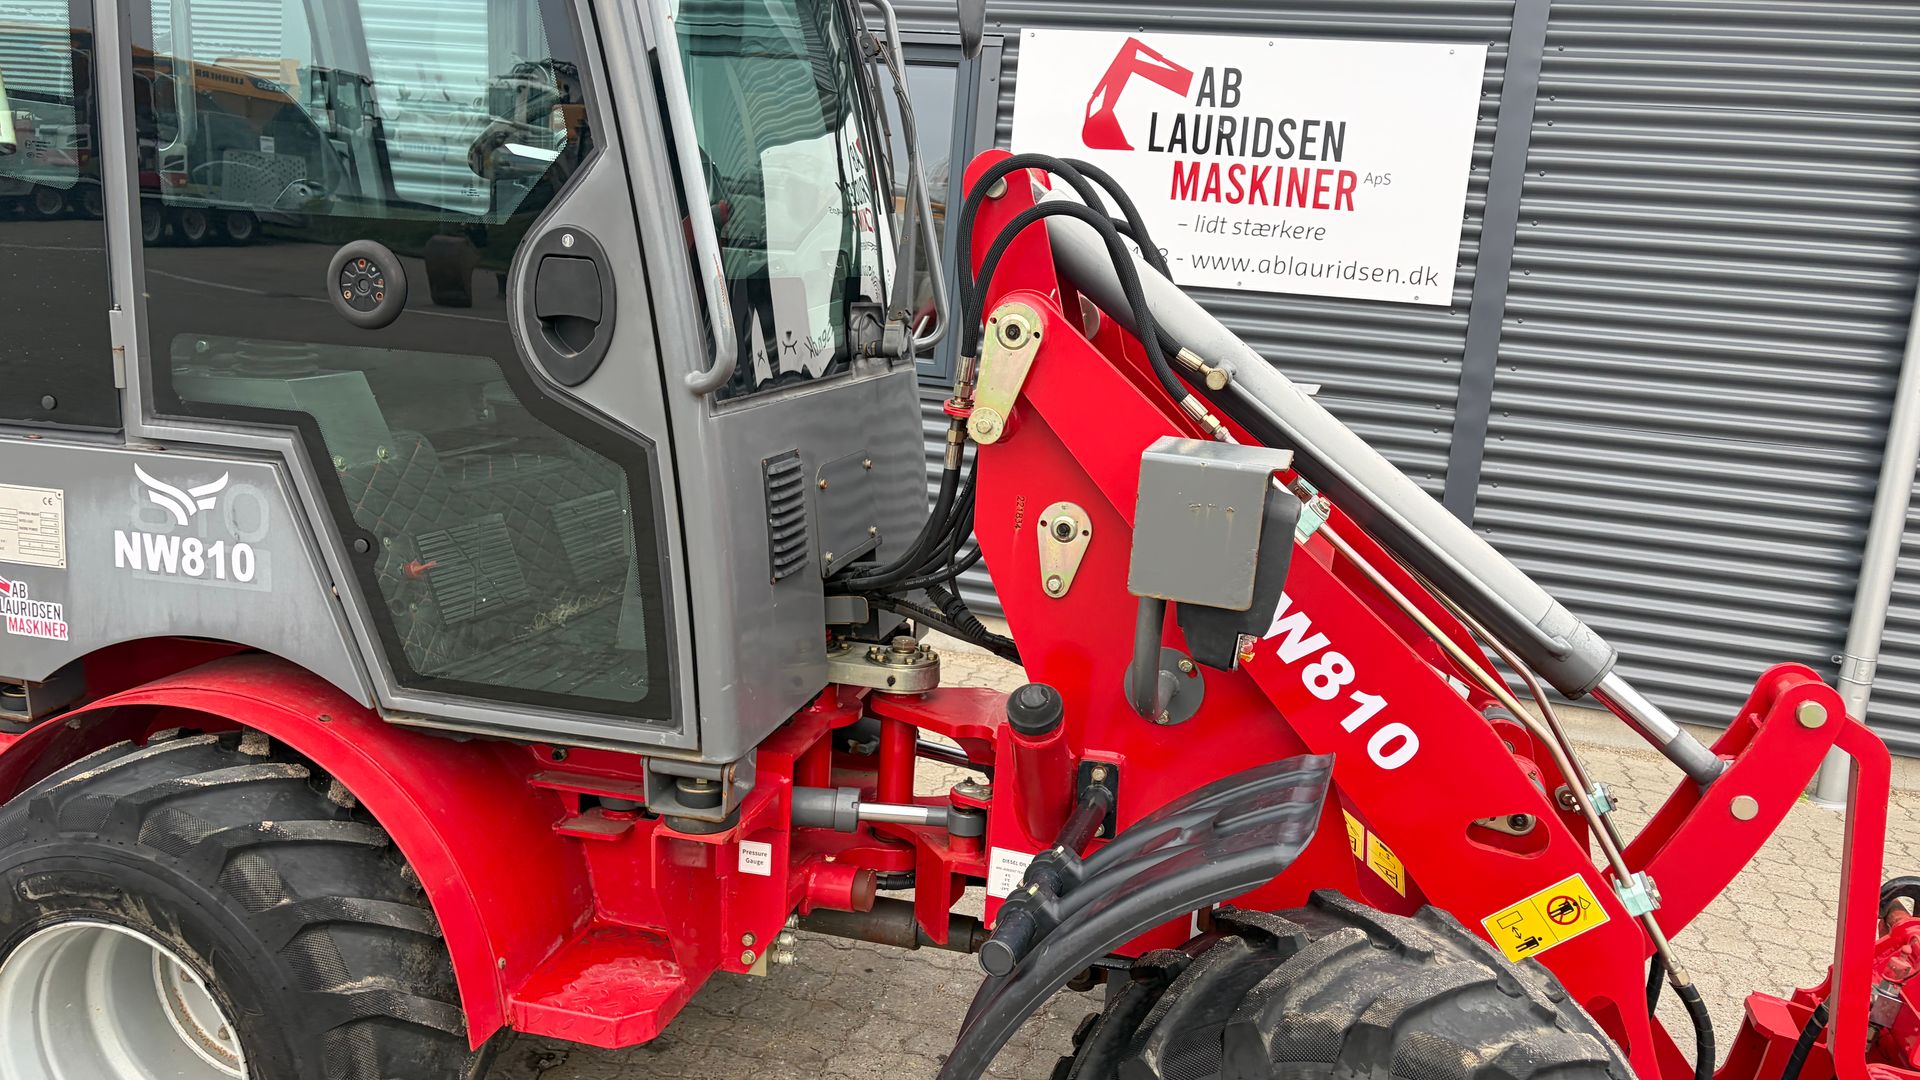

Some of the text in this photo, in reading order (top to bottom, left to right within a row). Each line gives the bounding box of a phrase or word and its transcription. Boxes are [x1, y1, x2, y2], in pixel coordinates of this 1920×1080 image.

[1196, 67, 1243, 108] AB
[1148, 112, 1346, 162] LAURIDSEN
[1170, 160, 1392, 211] MASKINER ApS
[1194, 215, 1227, 234] lidt
[1232, 219, 1326, 241] stærkere
[1191, 254, 1439, 287] www.ablauridsen.dk
[114, 530, 255, 582] NW810
[12, 582, 26, 599] AB
[0, 597, 61, 620] LAURIDSEN
[8, 616, 67, 639] MASKINER
[742, 848, 768, 857] Pressure
[745, 857, 764, 866] Gauge
